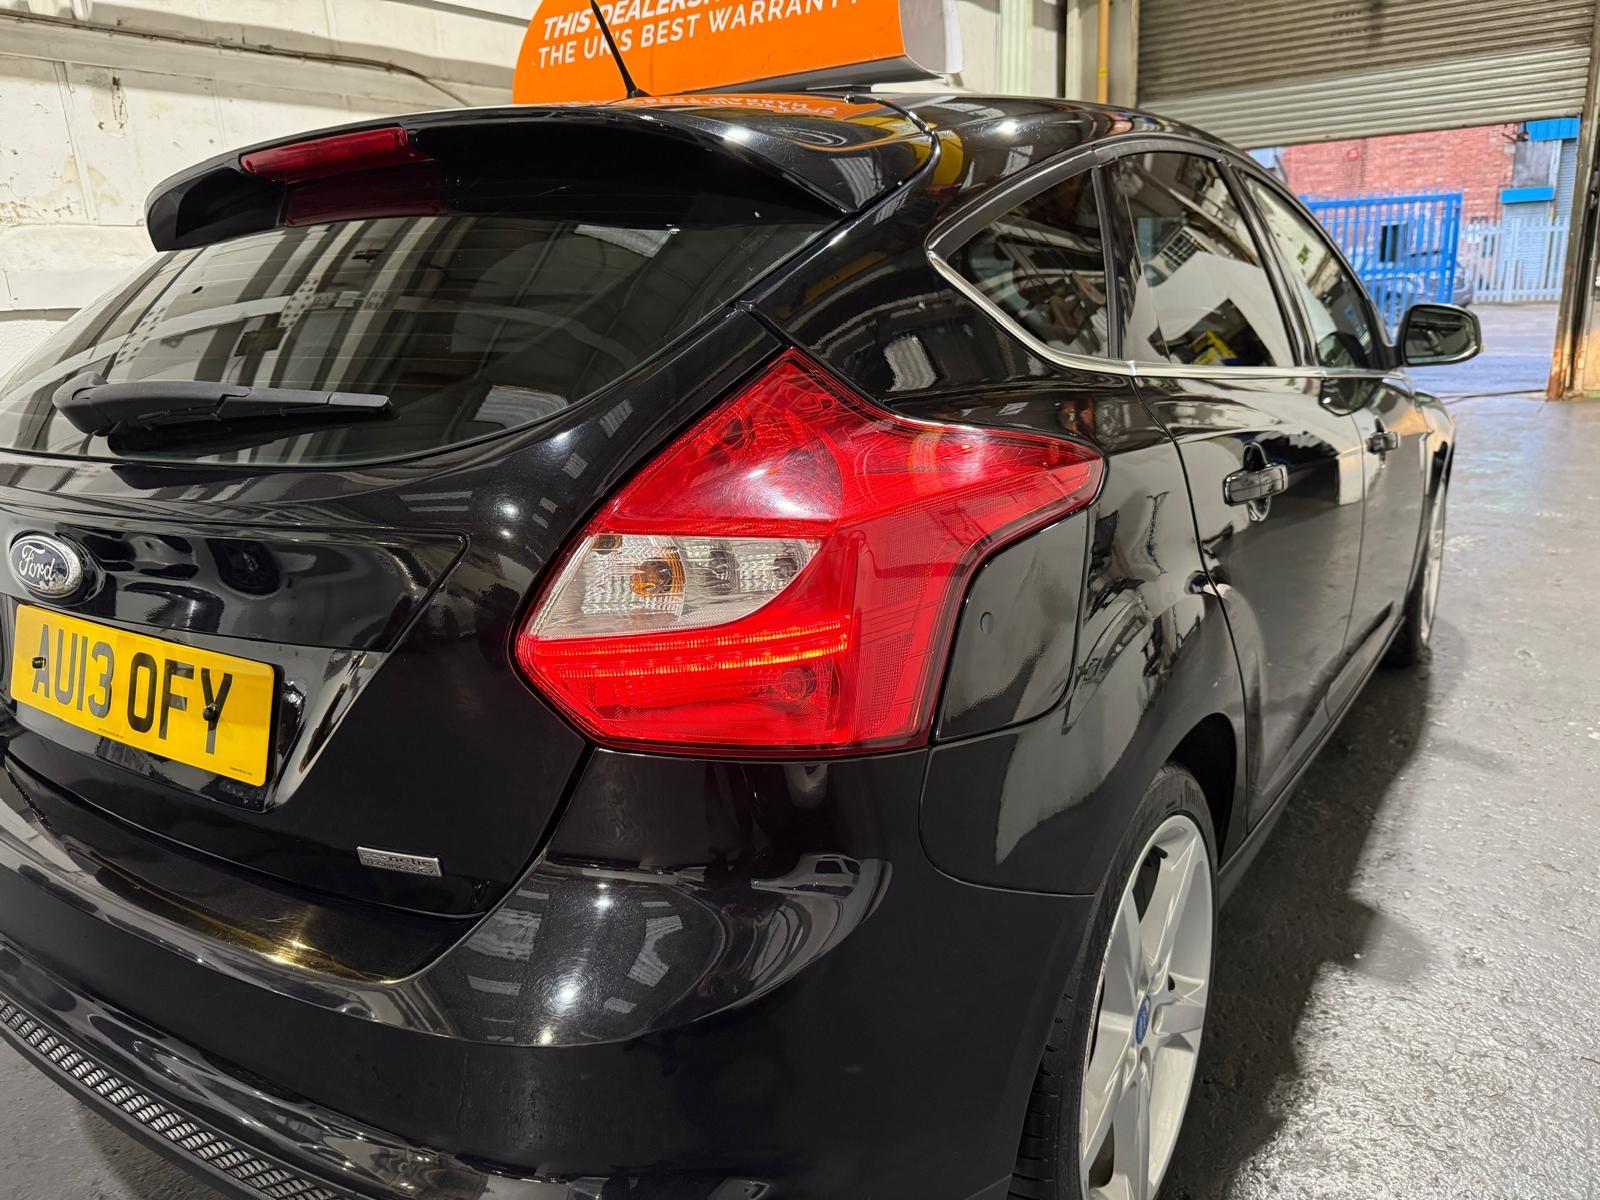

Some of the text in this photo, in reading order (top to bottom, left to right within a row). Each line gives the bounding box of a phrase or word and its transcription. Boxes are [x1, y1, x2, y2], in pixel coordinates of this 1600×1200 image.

[538, 0, 857, 69] THE UK'S BEST WARRAN
[544, 0, 718, 40] THIS DEALER
[19, 544, 56, 581] Ford
[32, 624, 233, 755] AU13 OFY
